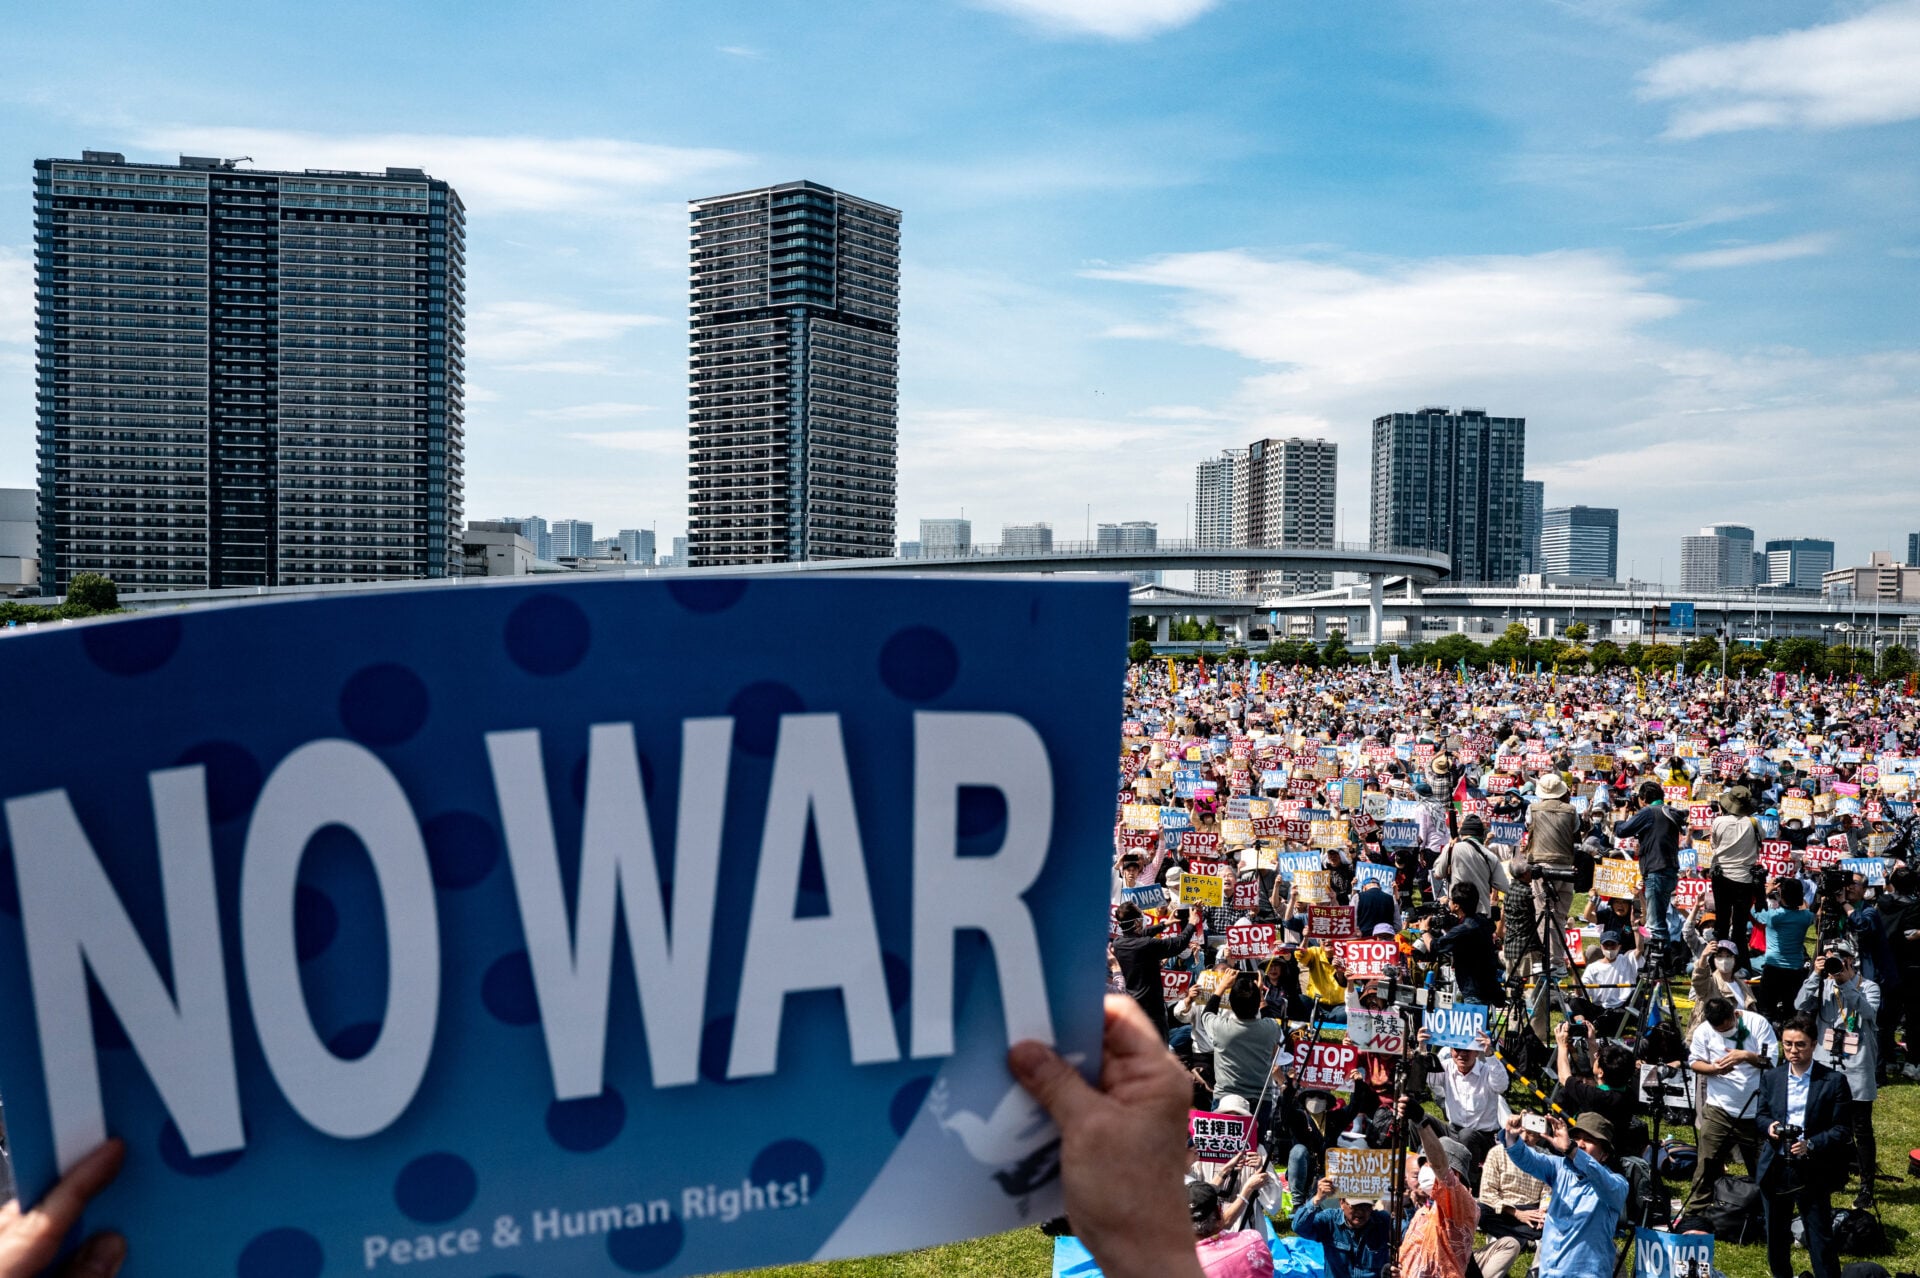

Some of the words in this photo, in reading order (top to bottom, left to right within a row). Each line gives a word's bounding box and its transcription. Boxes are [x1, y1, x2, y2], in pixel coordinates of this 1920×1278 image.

[1255, 761, 1276, 769] STOP
[1722, 762, 1741, 770] STOP
[1291, 780, 1316, 789] STOP
[1786, 790, 1806, 798] STOP
[1279, 801, 1305, 810] STOP
[1463, 801, 1487, 810] STOP
[1300, 811, 1309, 820] NO
[1312, 812, 1328, 820] WAR
[1353, 815, 1370, 828] TOP
[1170, 818, 1187, 827] WAR
[1253, 818, 1282, 829] STOP
[1287, 821, 1311, 832] STO
[1183, 833, 1216, 845] STOP
[1384, 826, 1396, 839] NO
[1398, 827, 1418, 840] WAR
[1492, 826, 1503, 838] NO
[1505, 827, 1523, 839] WAR
[1122, 836, 1151, 846] STOP
[1763, 843, 1789, 853] TOP
[1806, 848, 1839, 861] STOP
[1280, 859, 1295, 873] NO
[1297, 856, 1319, 871] WAR
[1761, 861, 1794, 874] STOP
[1843, 862, 1857, 872] NO
[1860, 862, 1882, 877] WAR
[1357, 866, 1371, 882] NO
[1373, 870, 1394, 888] WAR
[1235, 883, 1259, 897] STO
[1122, 892, 1136, 906] NO
[1138, 888, 1161, 903] WAR
[1312, 917, 1351, 935] 憲法
[1228, 926, 1272, 943] STOP
[4, 738, 441, 1174] NO
[484, 710, 1055, 1100] WAR
[1348, 943, 1397, 960] STOP
[1424, 1009, 1446, 1034] NO
[1450, 1011, 1483, 1037] WAR
[1368, 1033, 1401, 1052] NO
[1296, 1043, 1354, 1068] STOP
[1194, 1118, 1243, 1137] 性搾取
[1194, 1136, 1250, 1151] 許さない
[364, 1216, 480, 1269] Peace
[492, 1216, 521, 1248] &
[533, 1194, 671, 1240] Human
[683, 1175, 811, 1223] Rights!
[1637, 1239, 1663, 1276] NO
